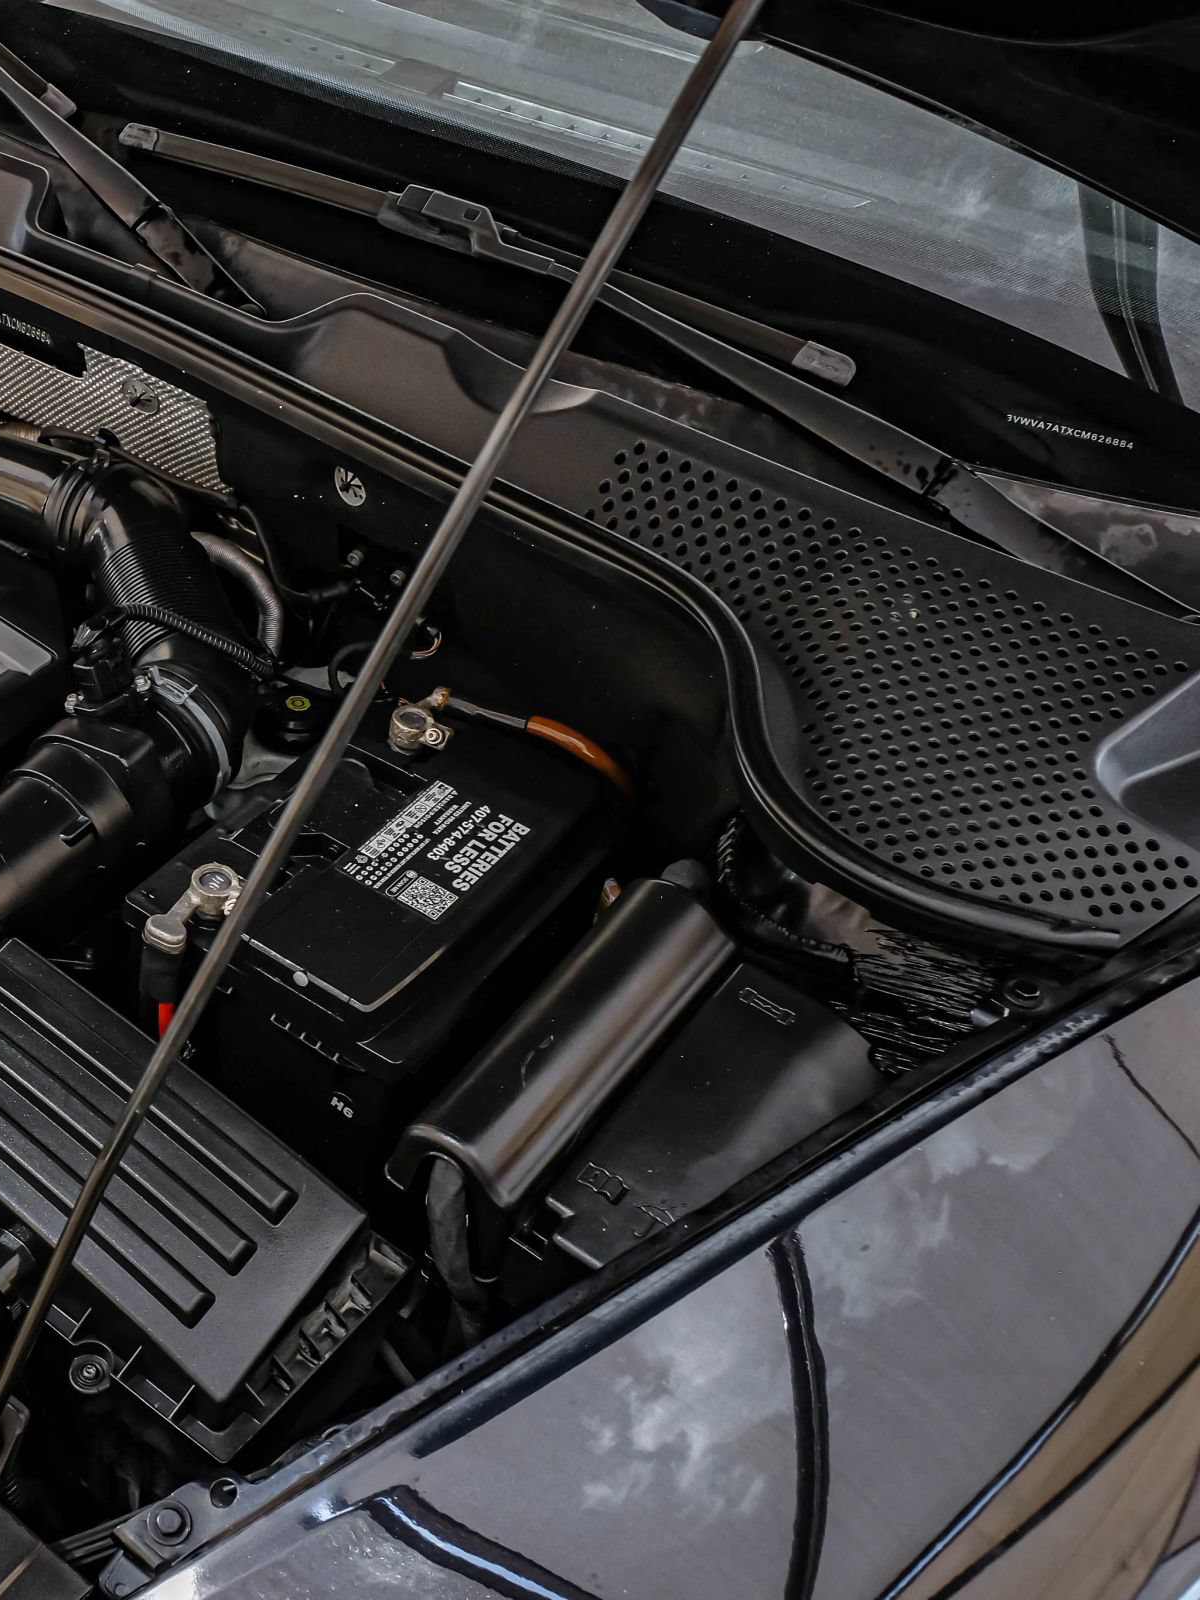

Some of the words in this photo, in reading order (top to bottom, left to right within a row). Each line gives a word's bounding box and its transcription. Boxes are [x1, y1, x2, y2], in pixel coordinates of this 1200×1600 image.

[1006, 414, 1134, 450] 3VWVA7ATXCM626884
[426, 804, 491, 861] 407-574-8403
[476, 813, 515, 842] FOR
[444, 837, 487, 874] LESS
[451, 821, 532, 892] BATTERIES
[330, 1096, 354, 1119] H6
